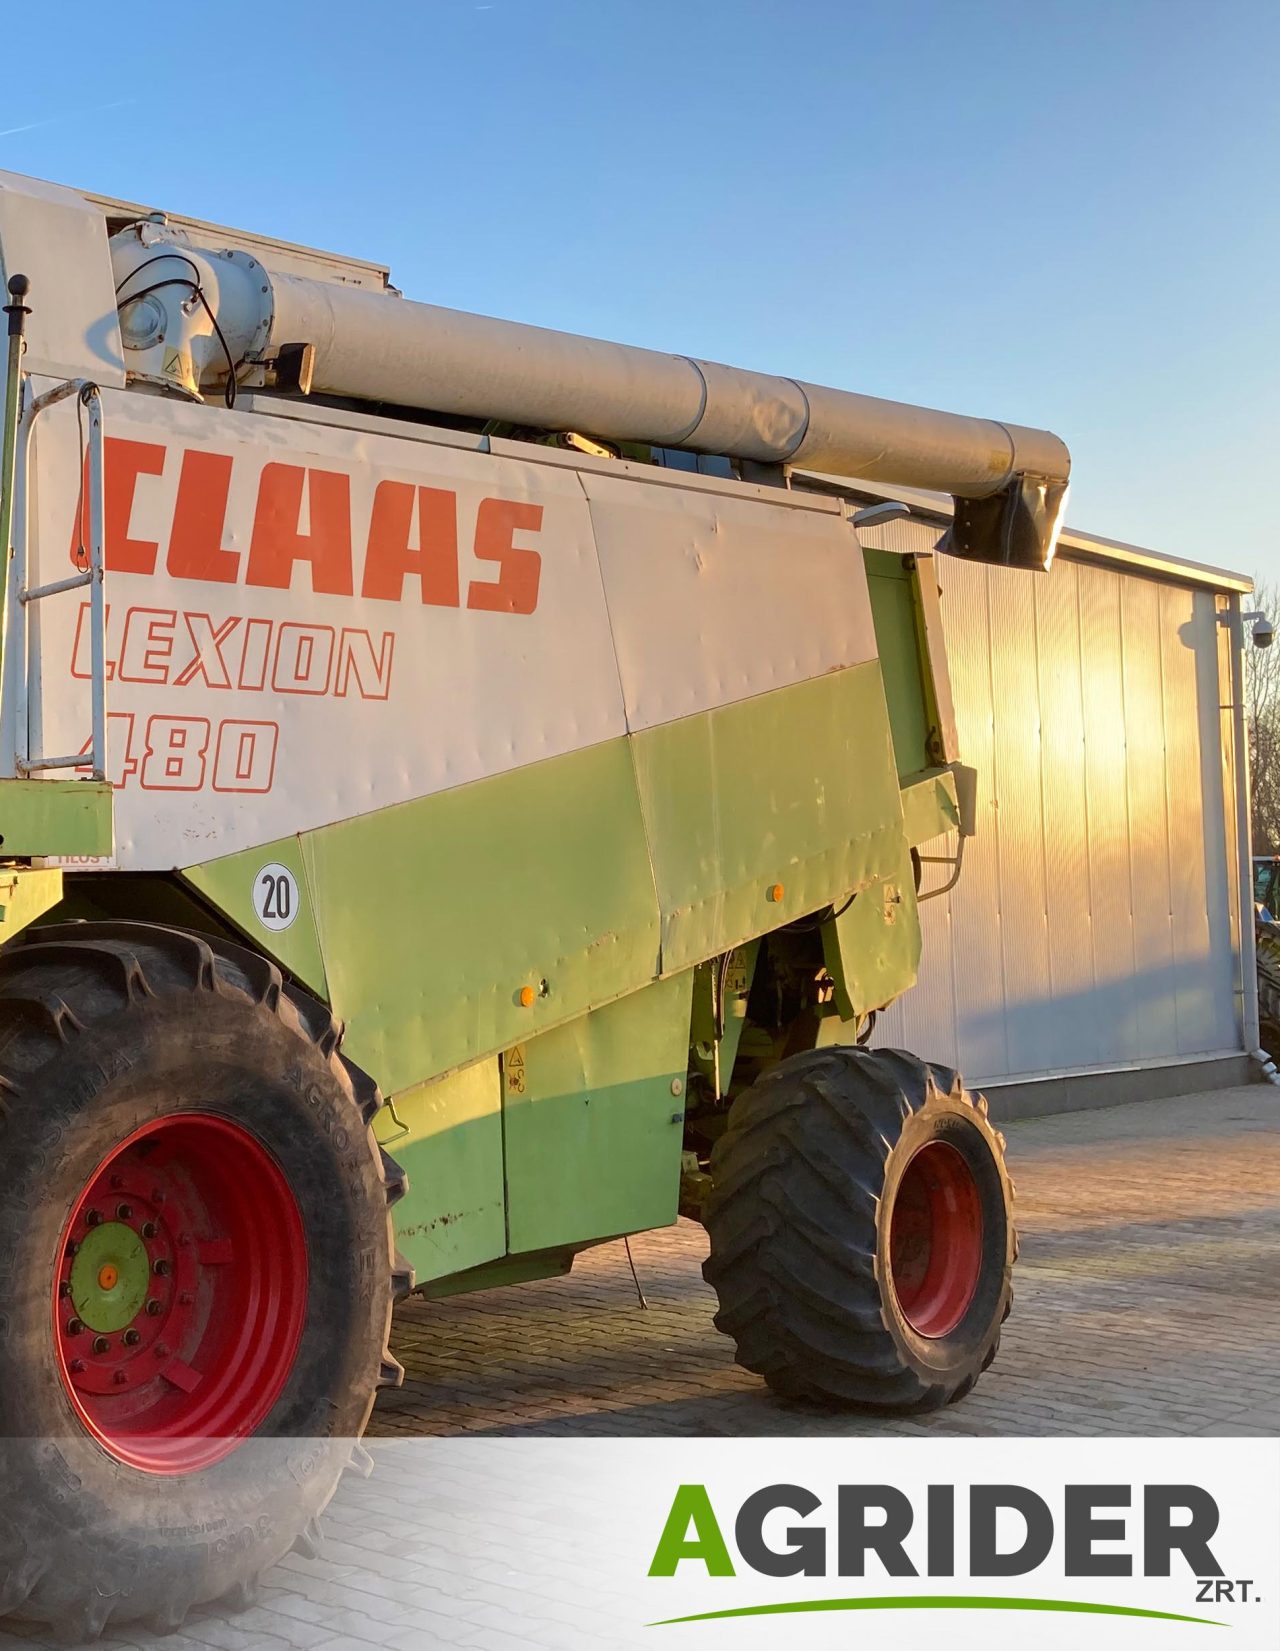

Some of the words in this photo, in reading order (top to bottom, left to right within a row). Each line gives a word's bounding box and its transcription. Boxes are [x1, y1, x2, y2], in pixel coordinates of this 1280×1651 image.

[70, 436, 544, 615] CLAAS
[70, 602, 396, 700] LEXION
[74, 712, 280, 794] 480
[261, 874, 291, 919] 20
